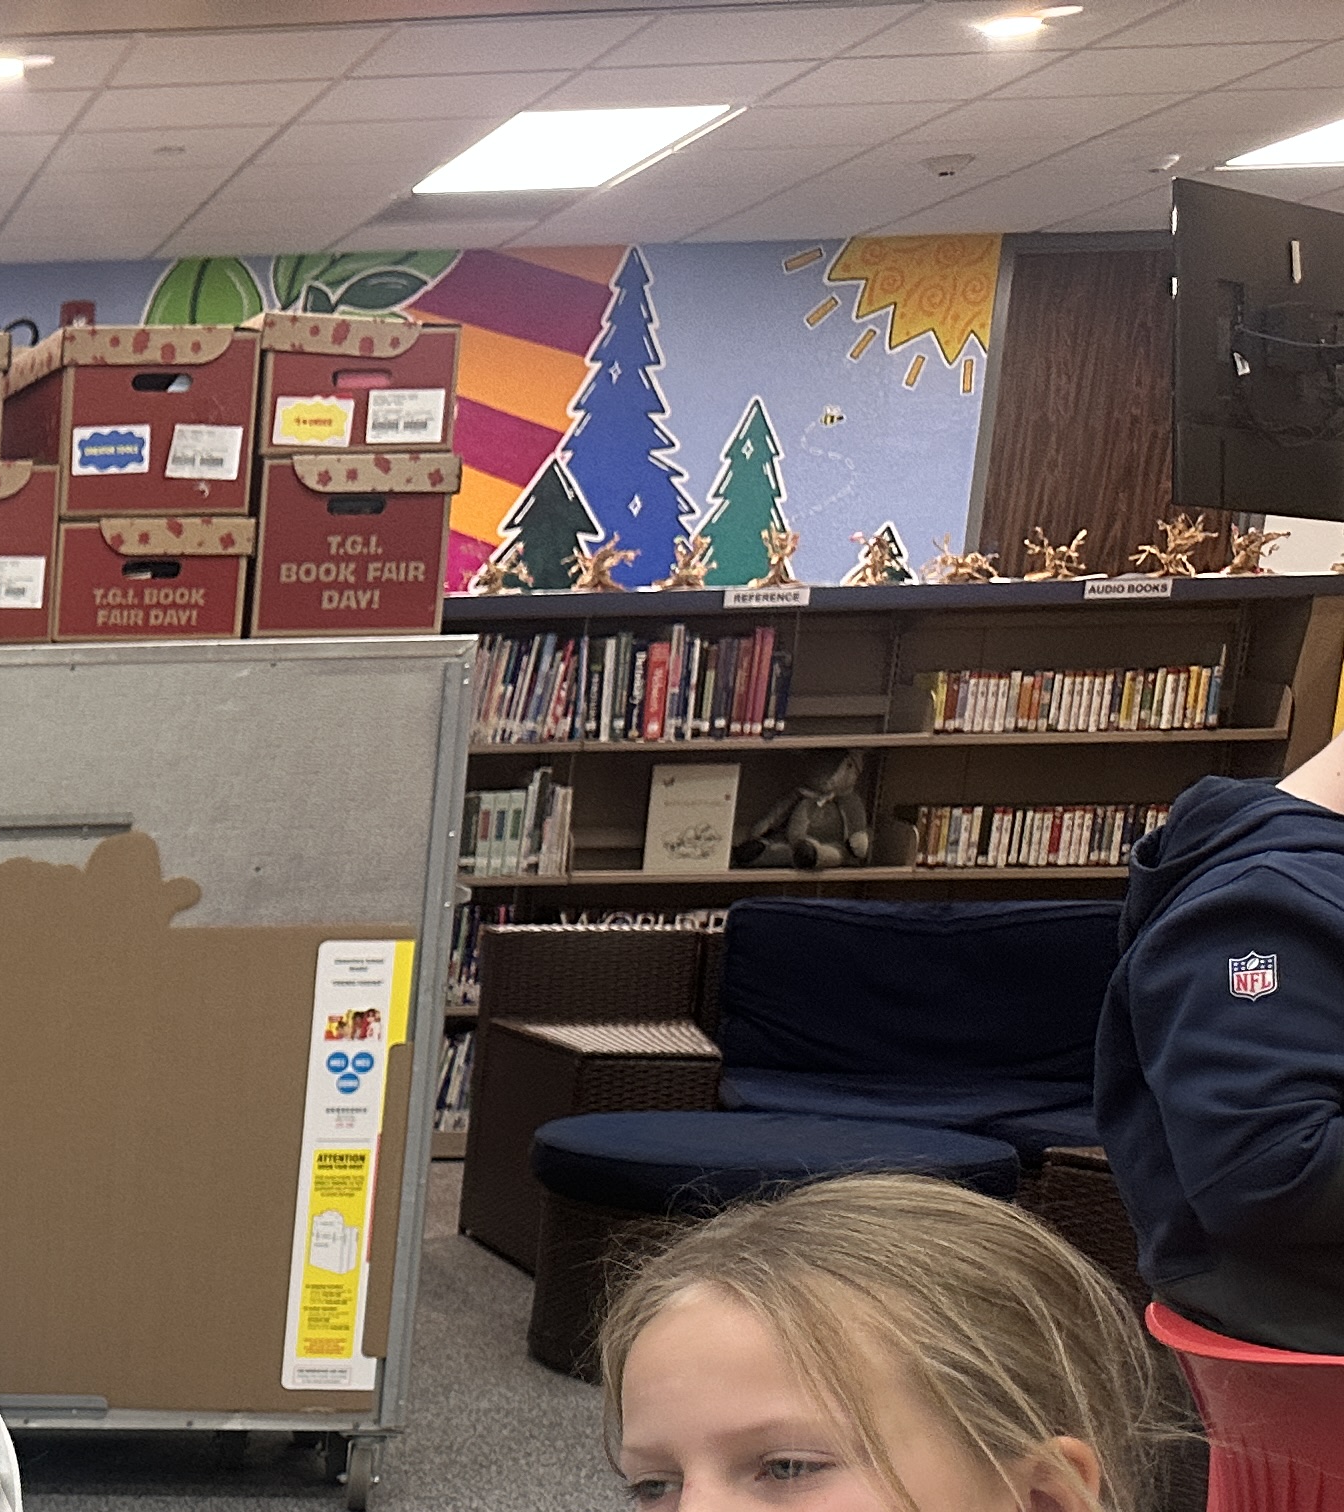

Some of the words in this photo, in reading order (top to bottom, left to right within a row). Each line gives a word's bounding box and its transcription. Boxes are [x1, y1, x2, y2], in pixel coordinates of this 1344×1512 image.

[326, 534, 384, 556] T.G.I.
[279, 561, 357, 584] BOOK
[366, 560, 426, 582] FAIR
[143, 586, 206, 606] BOOK
[320, 588, 380, 610] DAY!
[733, 591, 801, 605] REFERENCE
[1087, 584, 1126, 595] AUDIO
[1127, 582, 1169, 594] BOOKS
[96, 608, 145, 626] FAIR
[149, 607, 198, 626] DAY!
[1235, 971, 1272, 993] NFL
